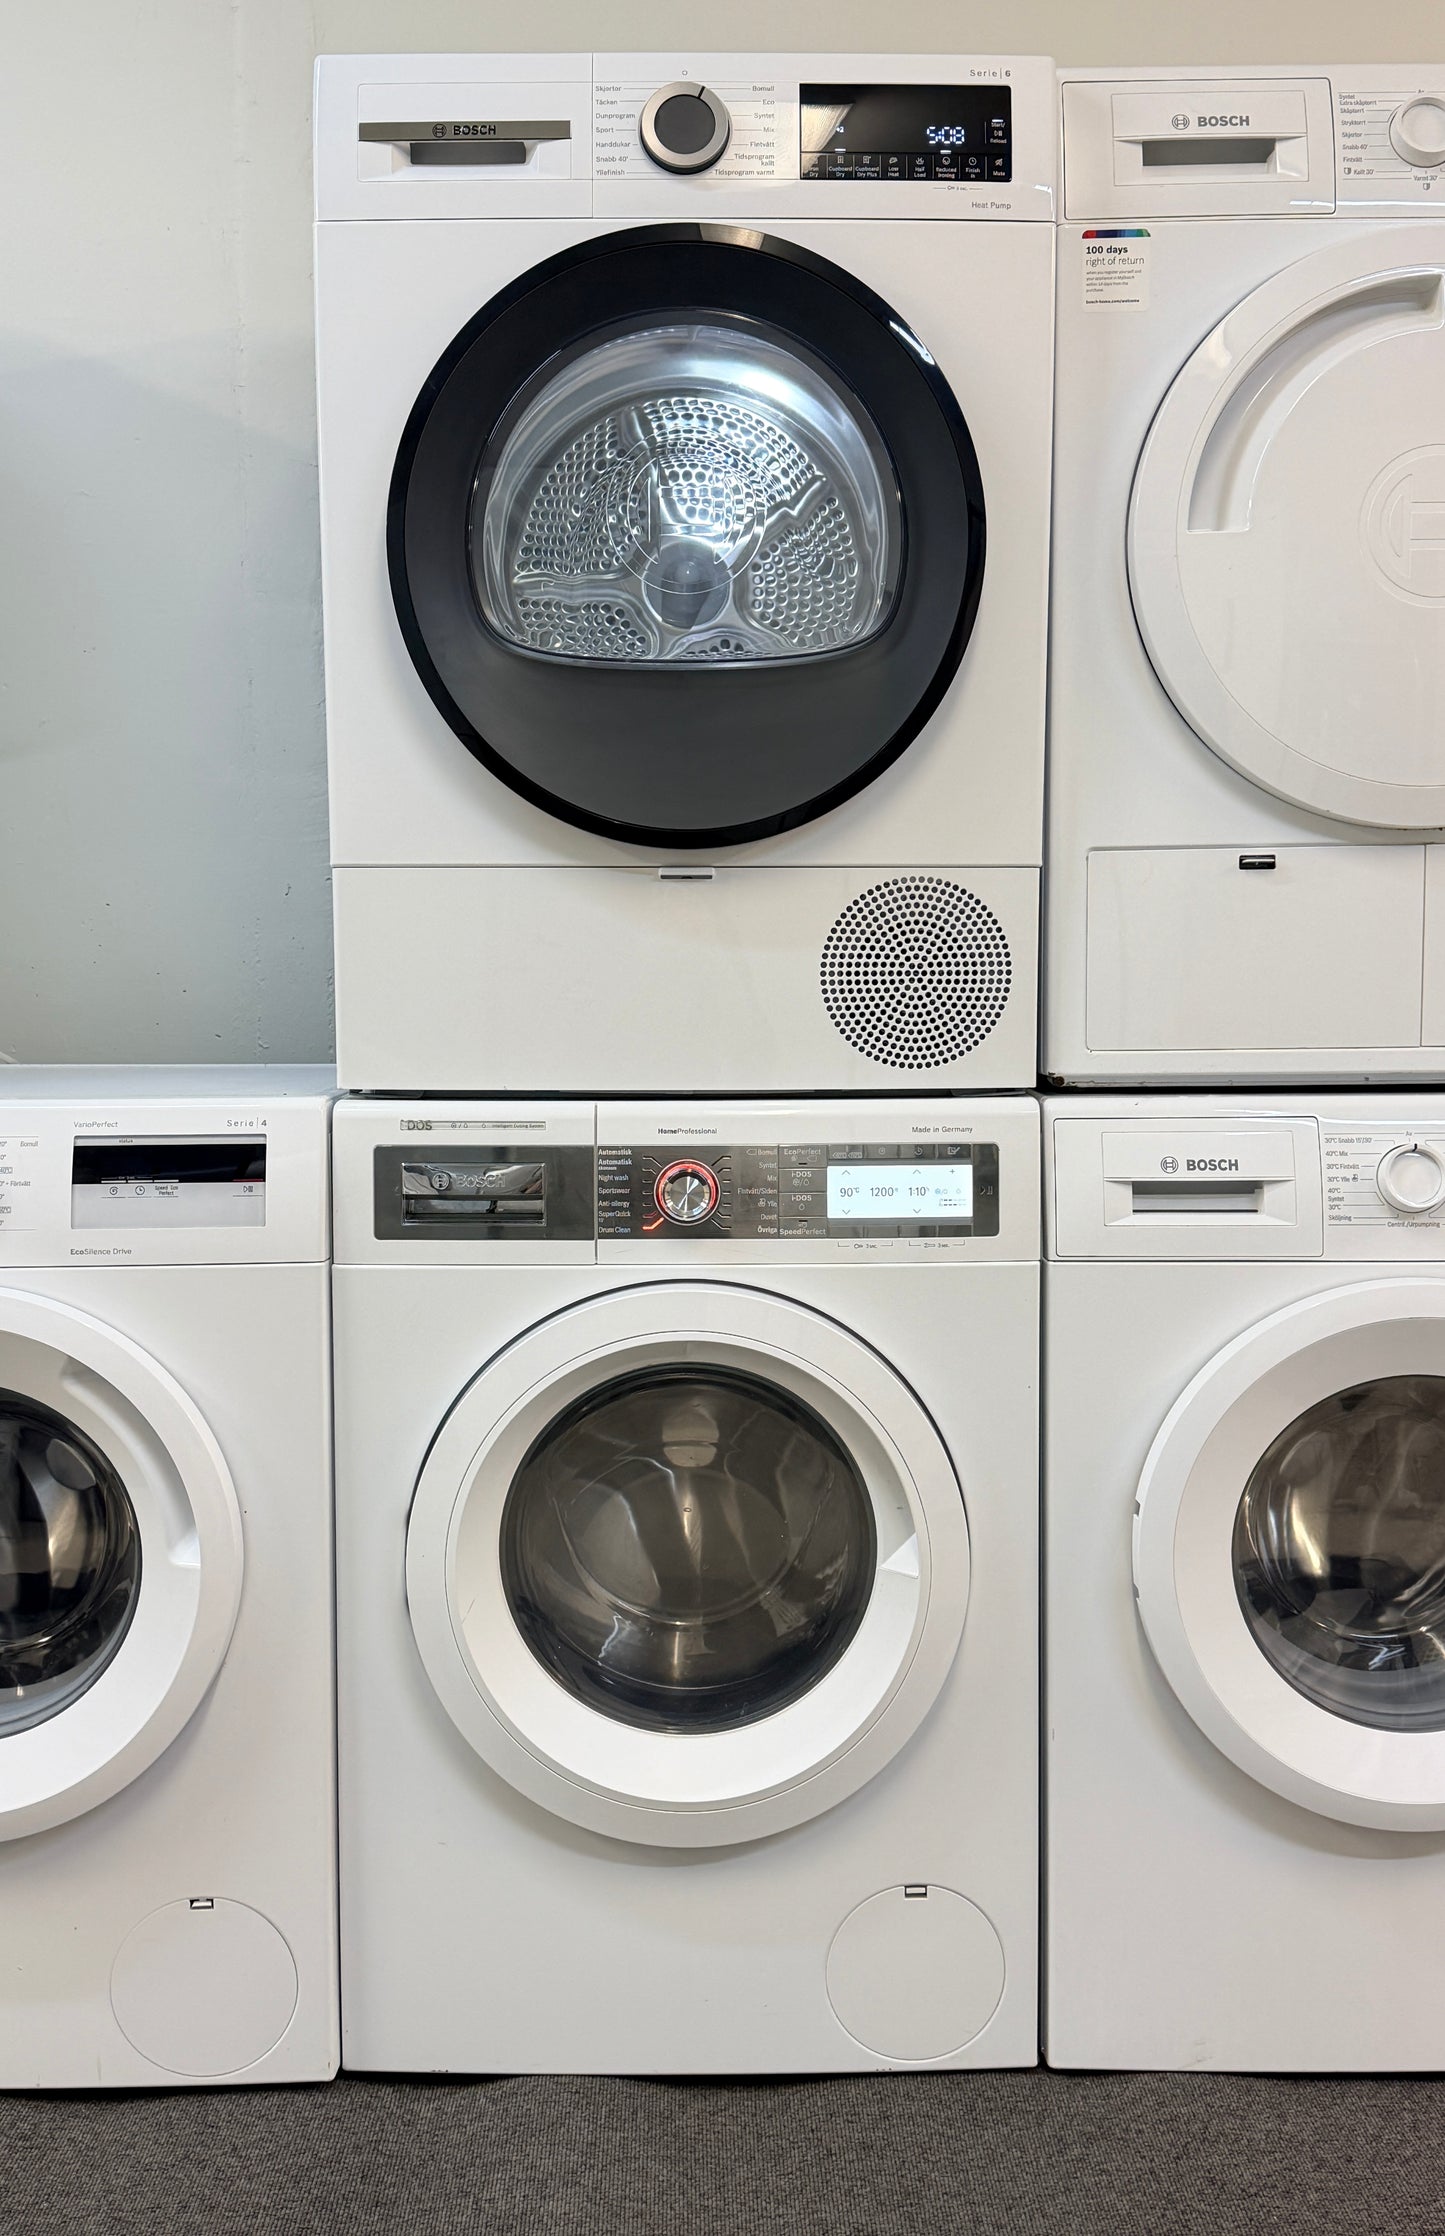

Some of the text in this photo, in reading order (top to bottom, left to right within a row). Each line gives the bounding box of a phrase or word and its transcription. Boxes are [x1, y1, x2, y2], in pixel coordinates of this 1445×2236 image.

[969, 69, 1011, 77] Serie 6
[1197, 114, 1250, 127] BOSCH
[452, 124, 497, 136] BOSCH
[926, 126, 965, 144] 5:08
[990, 201, 1012, 209] Pump
[1085, 245, 1128, 255] 100 days
[1085, 256, 1145, 267] right of return
[73, 1120, 119, 1128] VarioPerfect
[226, 1119, 267, 1127] Serie 4
[657, 1127, 718, 1135] HomeProfessional
[941, 1125, 973, 1133] Germany
[598, 1148, 632, 1156] Automatisk
[783, 1147, 821, 1155] EcoPerfect
[758, 1161, 777, 1169] Syntet
[1186, 1158, 1239, 1171] BOSCH
[456, 1174, 506, 1188] BOSCH
[598, 1173, 629, 1182] Night wash
[598, 1187, 631, 1195] Sportswear
[869, 1186, 895, 1197] 1200
[598, 1200, 630, 1208] Anti-allergy
[598, 1210, 631, 1218] SuperQuick
[1328, 1214, 1352, 1222] Sköljning
[757, 1225, 778, 1234] Övriga
[779, 1228, 826, 1236] SpeedPerfect
[70, 1247, 132, 1256] EcoSilence Drive
